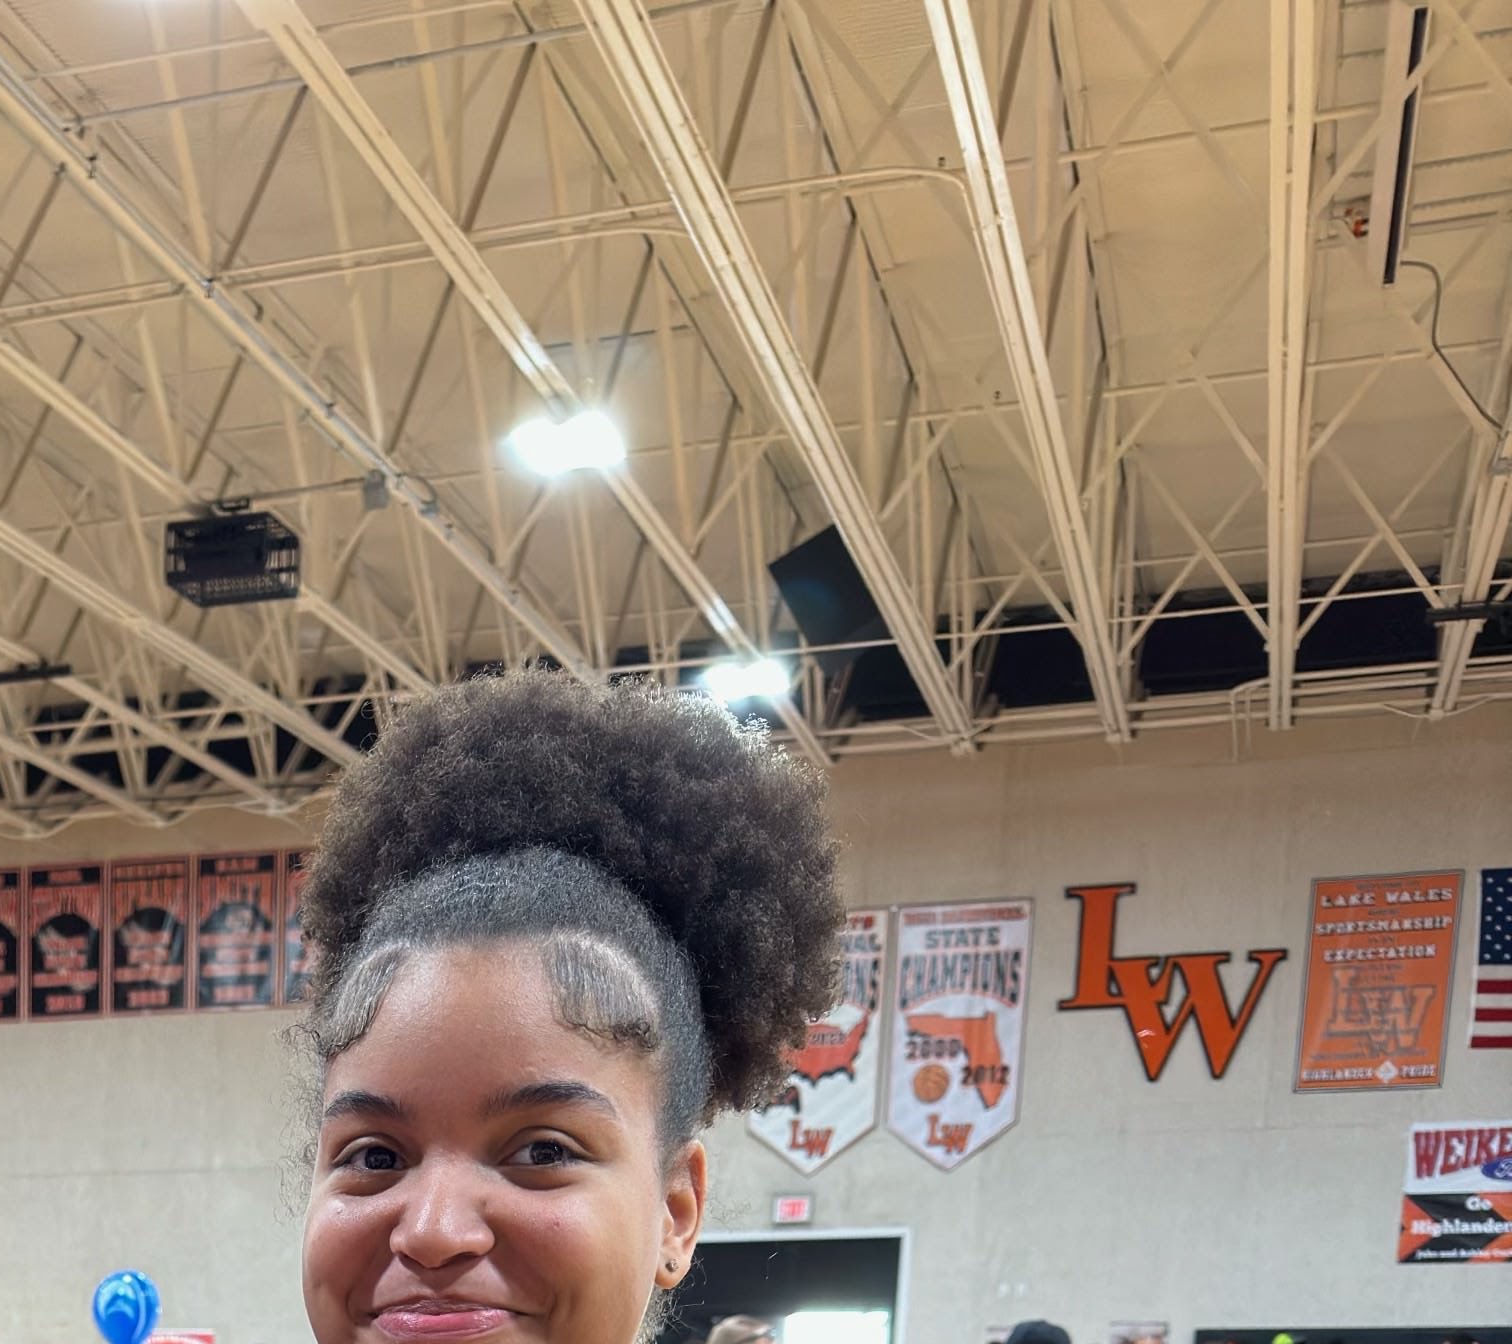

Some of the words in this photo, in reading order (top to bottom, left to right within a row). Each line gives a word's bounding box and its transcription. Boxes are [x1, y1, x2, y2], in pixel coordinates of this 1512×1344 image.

[1321, 892, 1376, 908] LAKE
[1386, 887, 1454, 905] WALES
[1315, 916, 1453, 936] SPORTSMANSHIP
[925, 926, 1000, 949] STATE
[1324, 944, 1437, 963] EXPECTATION
[899, 950, 1023, 1010] CHAMPIONS
[1465, 1195, 1493, 1212] Go
